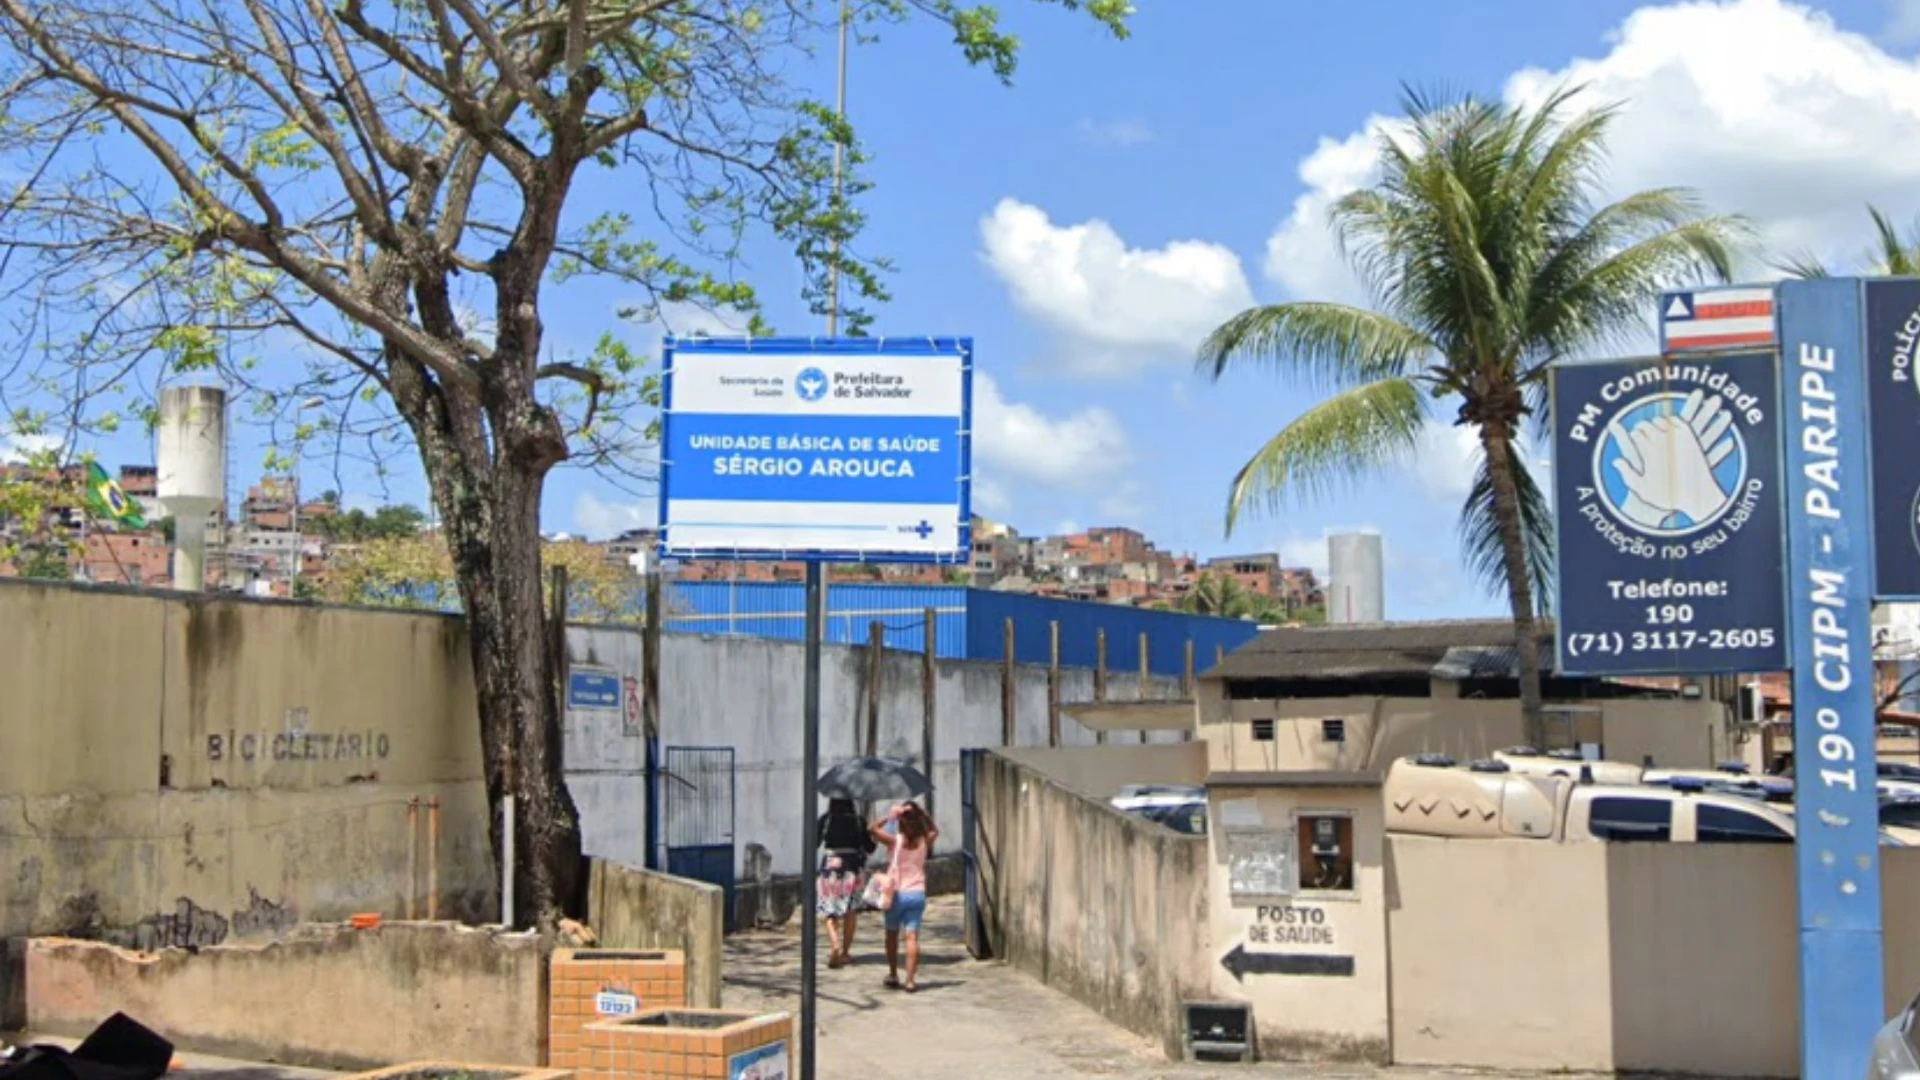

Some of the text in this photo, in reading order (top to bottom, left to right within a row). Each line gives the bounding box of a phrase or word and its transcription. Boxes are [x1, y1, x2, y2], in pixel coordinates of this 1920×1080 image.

[834, 373, 904, 386] Prefeitura
[833, 386, 912, 399] de Salvador
[1569, 365, 1764, 442] PM Comunidade
[1800, 341, 1842, 520] PARIPE
[689, 432, 940, 452] UNIDADE BÁSICA DE SAÚDE
[713, 453, 914, 477] SÉRGIO AROUCA
[1576, 478, 1764, 560] A proteção no seu bairro
[1607, 579, 1728, 599] Telefone:
[1646, 604, 1694, 624] 190
[1809, 568, 1852, 692] CIPM
[1567, 628, 1775, 656] (71) 3117-2605
[1257, 905, 1325, 924] POSTO
[1250, 926, 1269, 942] DE
